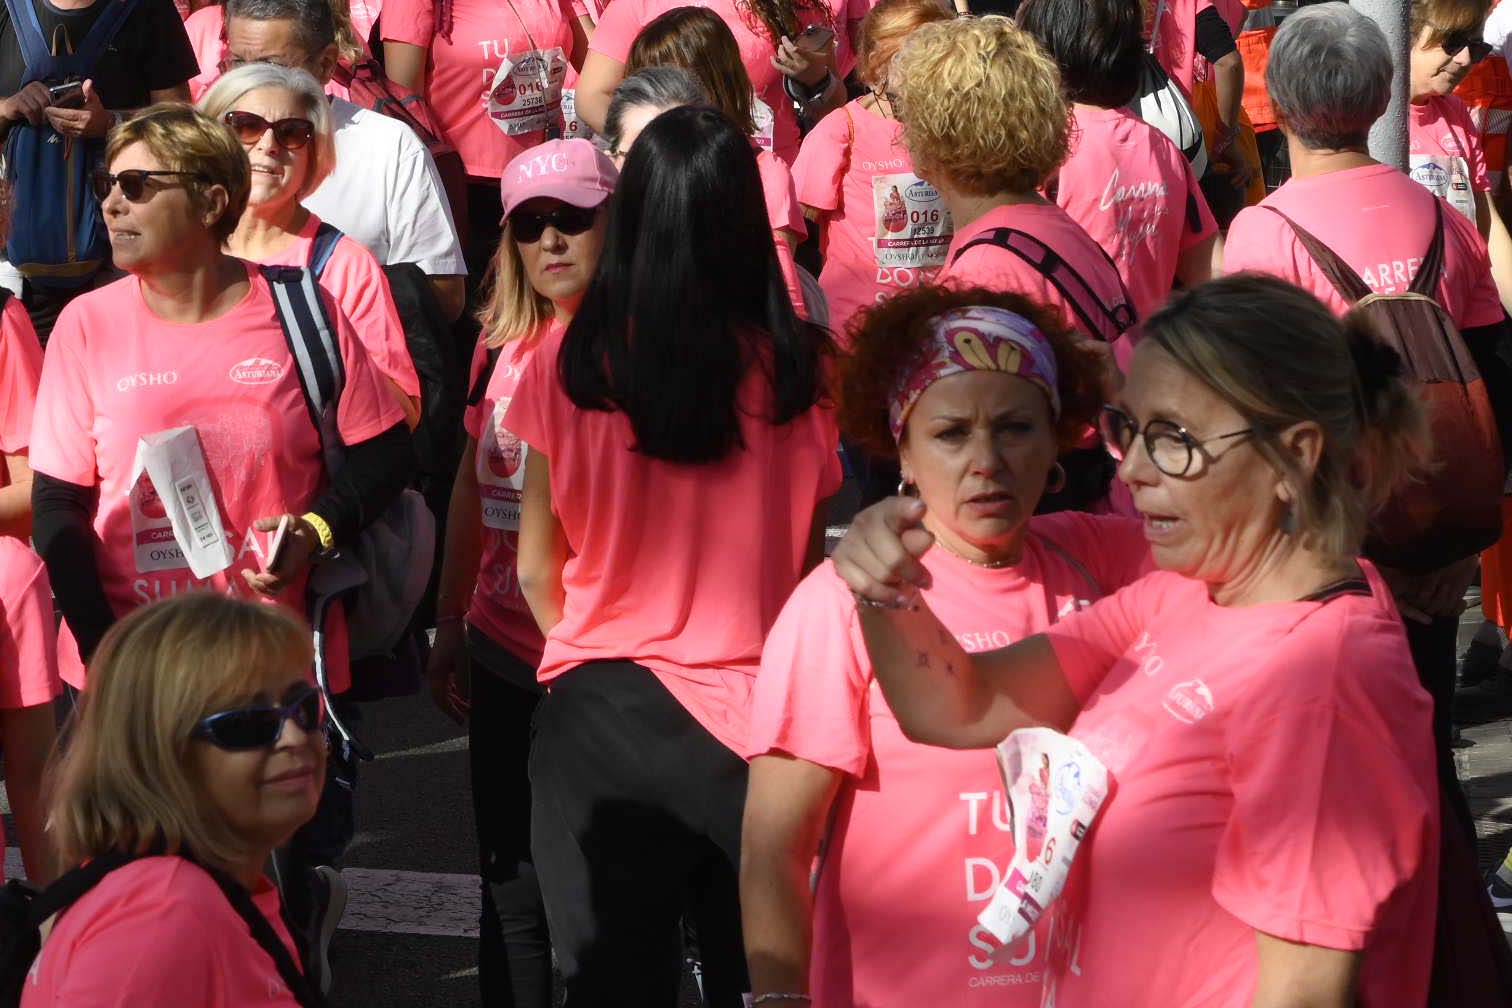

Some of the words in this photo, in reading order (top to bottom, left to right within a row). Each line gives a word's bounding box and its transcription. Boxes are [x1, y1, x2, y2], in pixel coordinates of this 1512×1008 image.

[478, 39, 509, 60] TU
[908, 188, 938, 198] ASTURIA
[910, 209, 940, 224] 016
[1361, 256, 1425, 289] ARRE
[117, 371, 178, 393] OYSHO
[151, 530, 174, 541] CARR
[150, 549, 186, 561] OYSH
[968, 973, 1023, 988] CARRERA
[1024, 972, 1041, 984] DE
